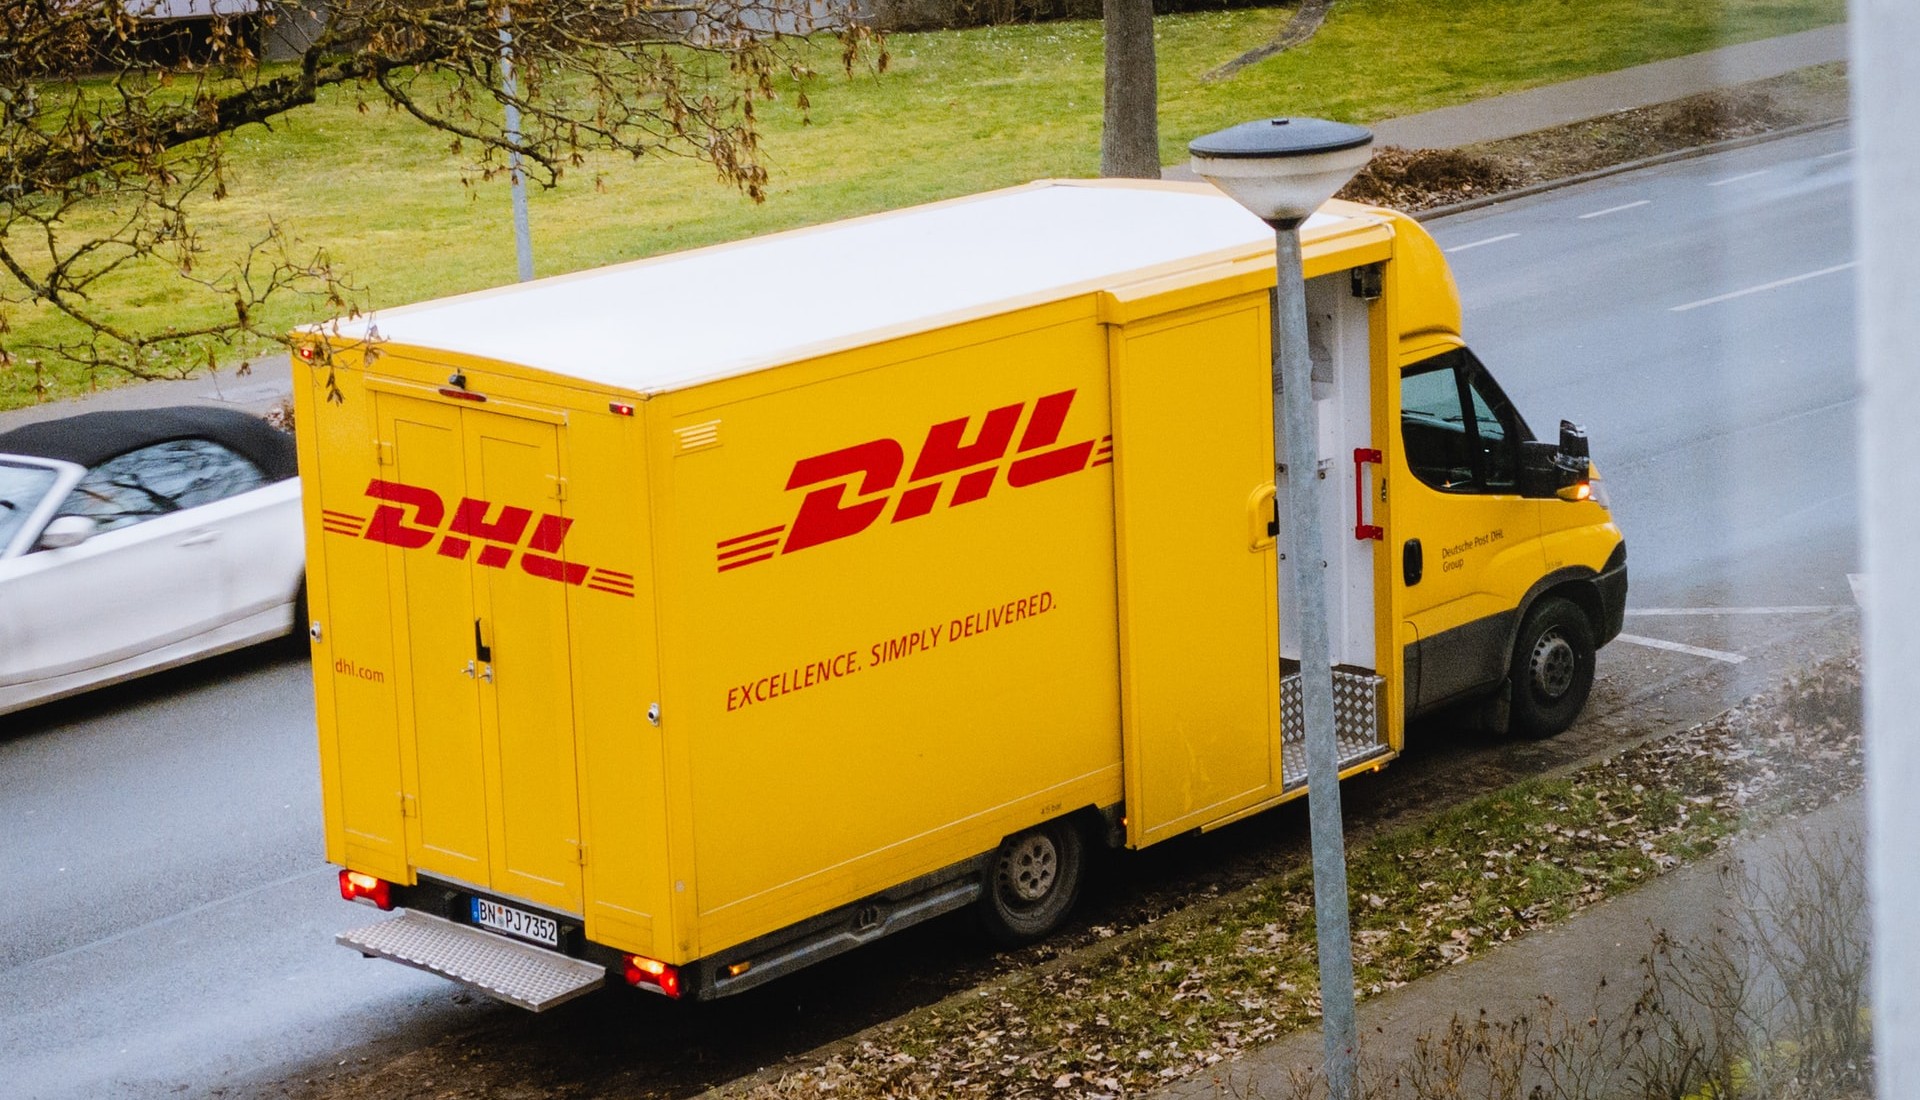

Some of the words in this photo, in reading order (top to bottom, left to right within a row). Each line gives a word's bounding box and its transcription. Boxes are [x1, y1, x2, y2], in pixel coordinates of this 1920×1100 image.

[781, 388, 1096, 556] DHL
[363, 478, 591, 586] DHL
[1442, 540, 1474, 559] Deutsche
[1474, 533, 1489, 547] Post
[1490, 529, 1503, 542] DHL
[1443, 558, 1464, 572] Group
[335, 658, 385, 684] dhl.com
[727, 651, 862, 712] EXCELLENCE.
[870, 624, 943, 667] SIMPLY
[949, 591, 1057, 642] DELIVERED.
[479, 901, 496, 924] BN
[505, 910, 521, 931] PJ
[525, 915, 555, 942] 7352
